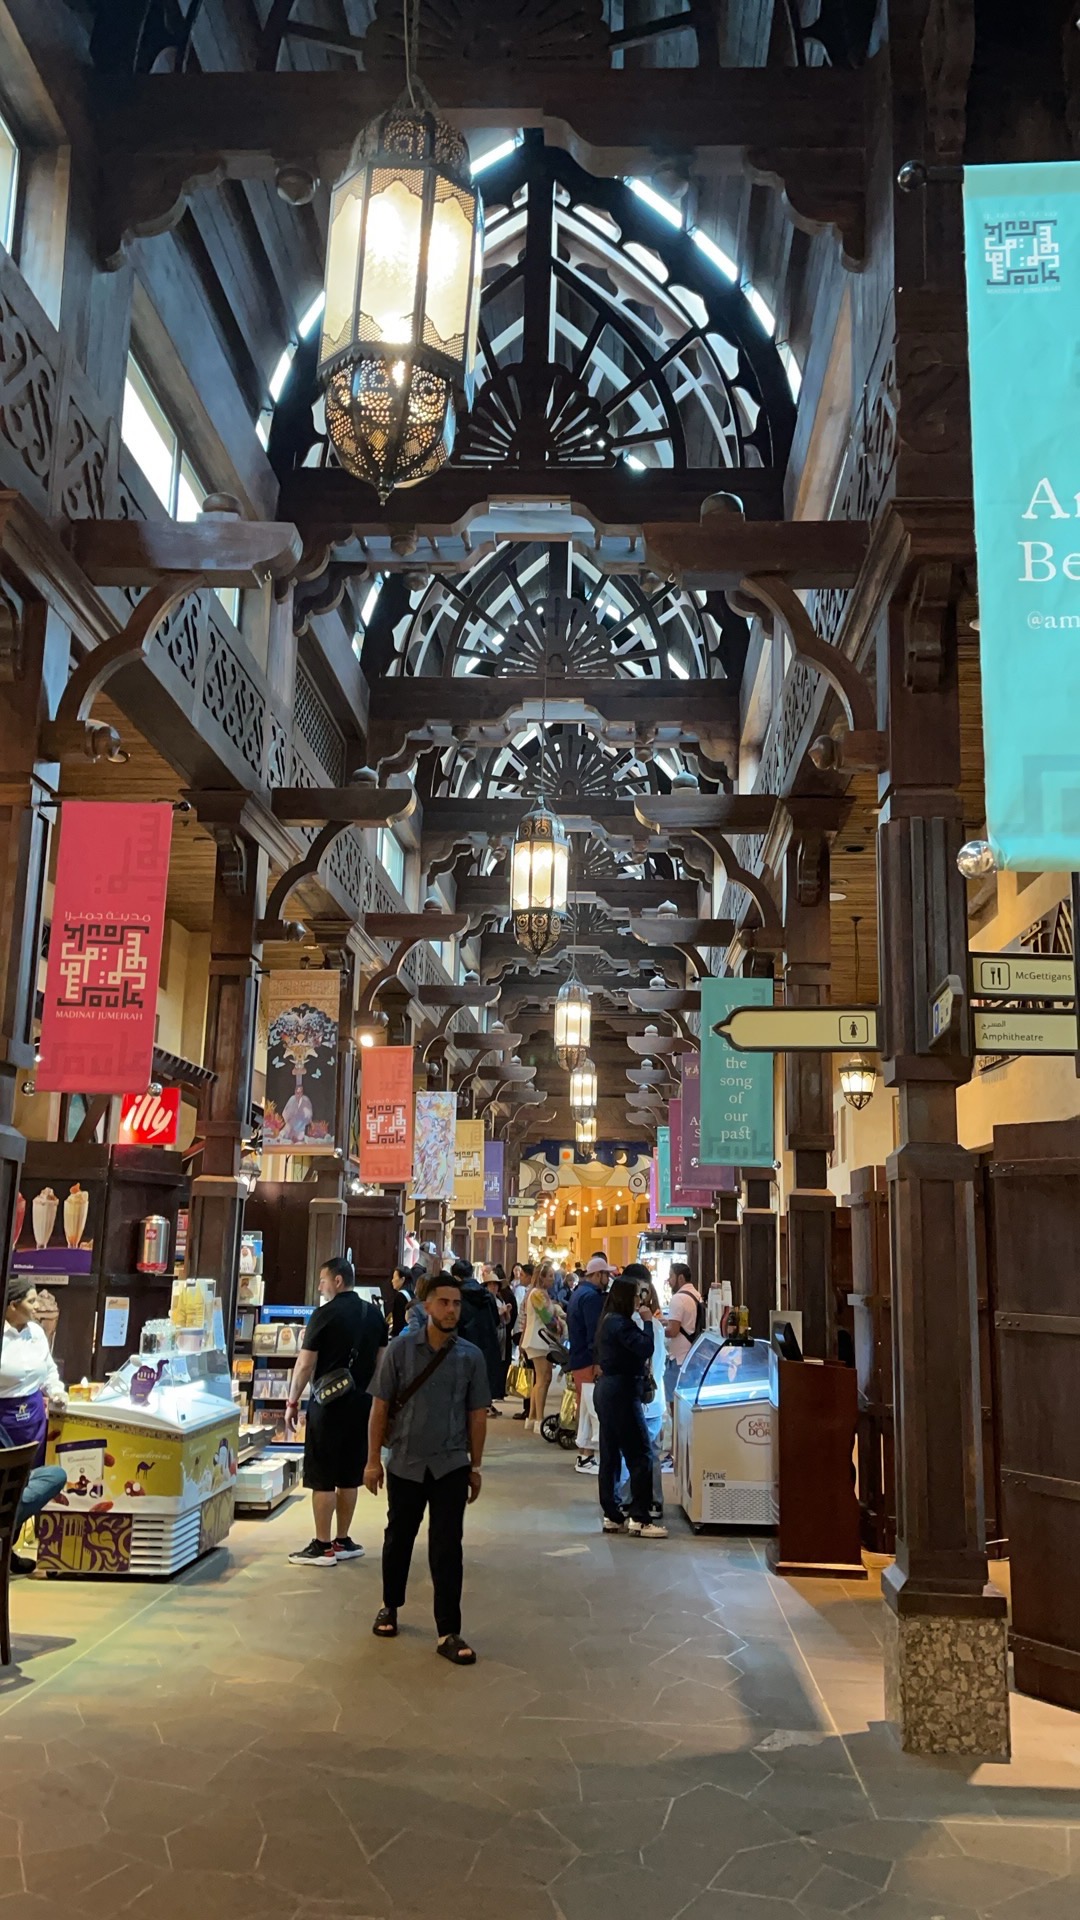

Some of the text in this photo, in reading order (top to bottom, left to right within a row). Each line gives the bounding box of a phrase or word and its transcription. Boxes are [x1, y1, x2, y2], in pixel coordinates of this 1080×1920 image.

[1017, 541, 1080, 581] Be
[1015, 971, 1072, 982] McGettigans
[56, 1010, 143, 1020] MADINAT JUMEIRAH
[982, 1032, 1044, 1042] Amphitheatre
[726, 1057, 747, 1069] the
[720, 1075, 753, 1089] song
[729, 1092, 744, 1104] of
[123, 1093, 173, 1139] illy
[724, 1112, 748, 1122] our
[721, 1126, 751, 1142] past
[320, 1378, 349, 1400] COACH
